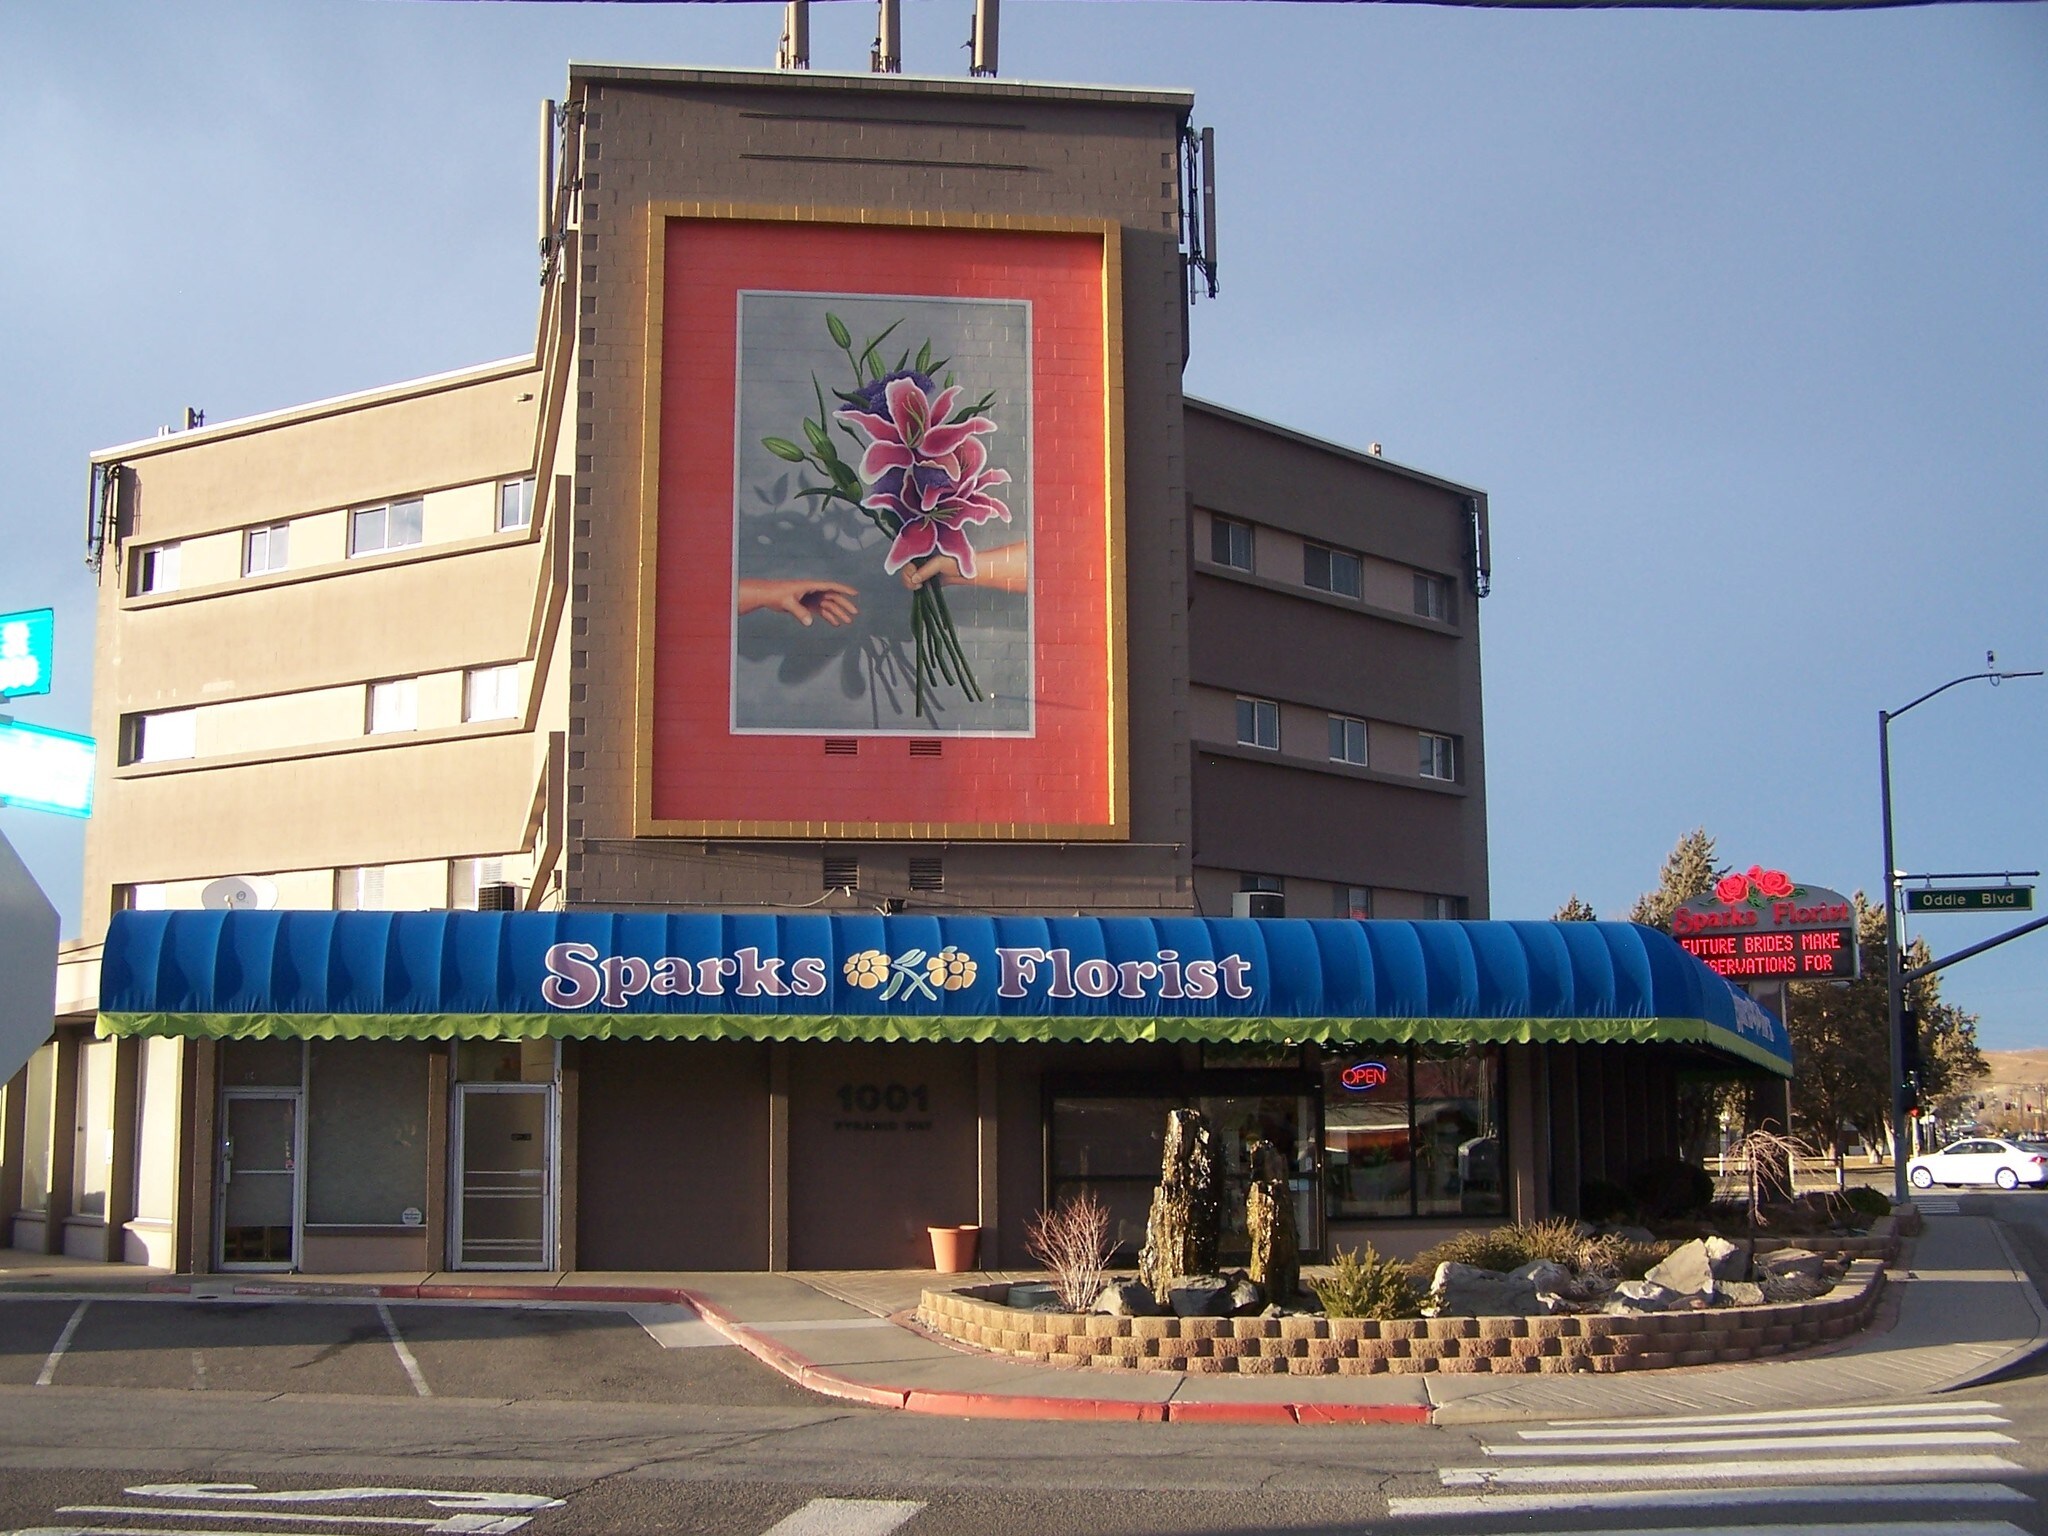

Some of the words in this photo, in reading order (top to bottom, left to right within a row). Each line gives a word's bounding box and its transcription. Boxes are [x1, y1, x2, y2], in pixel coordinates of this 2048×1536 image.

[1922, 894, 1966, 906] Oddie
[1981, 892, 2015, 904] Blvd
[1672, 905, 1757, 934] Sparks
[1772, 901, 1850, 924] Florist
[1681, 937, 1737, 956] FUTURE
[1744, 936, 1794, 954] BRIDES
[1801, 932, 1841, 950] MAKE
[542, 942, 827, 1009] Sparks
[995, 947, 1252, 999] Florist
[1702, 954, 1796, 976] SERVATIONS
[1804, 954, 1833, 972] FOR
[1342, 1069, 1386, 1085] OPEN
[836, 1083, 928, 1113] 1001
